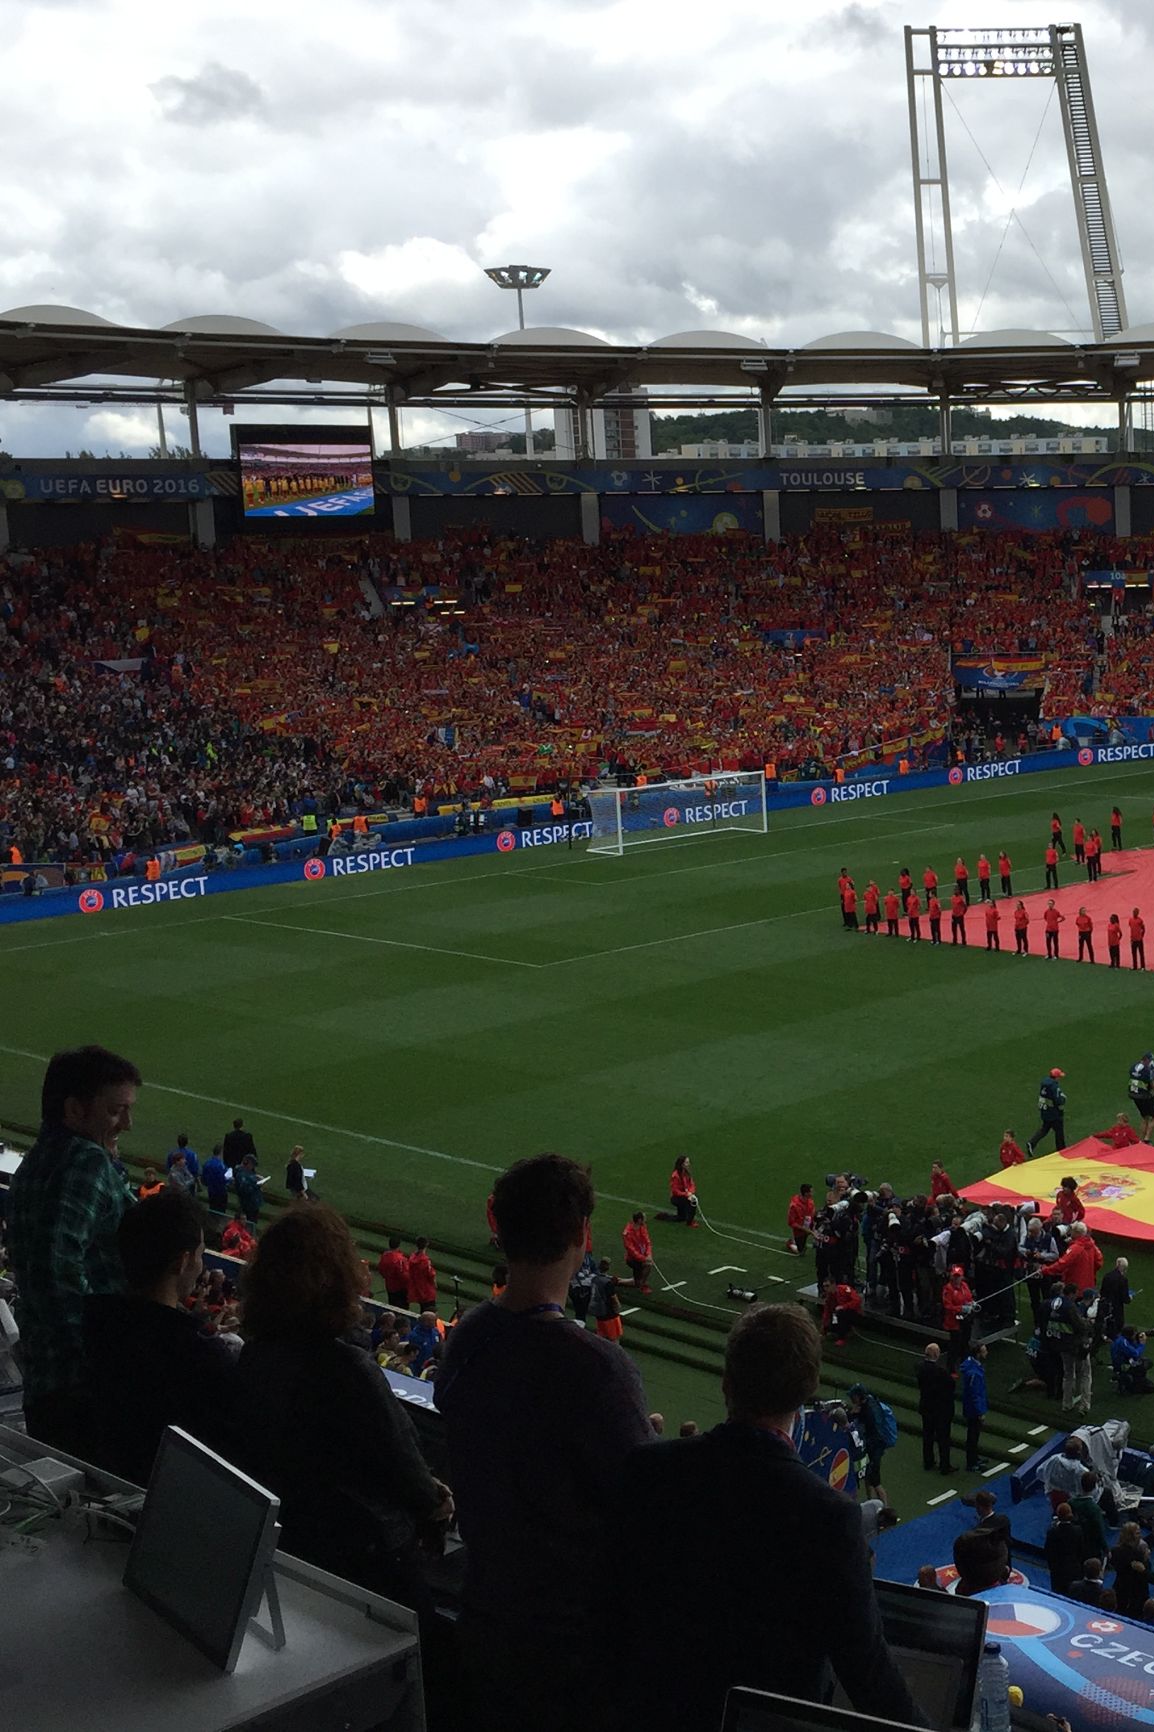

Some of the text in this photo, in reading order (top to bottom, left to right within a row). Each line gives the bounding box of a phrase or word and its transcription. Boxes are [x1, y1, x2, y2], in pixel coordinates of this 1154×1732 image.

[40, 479, 200, 494] UEFA EURO 2016
[779, 472, 865, 486] TOULOUSE
[967, 759, 1022, 782] RESPECT
[831, 780, 890, 803] RESPECT
[685, 800, 748, 824] RESPECT
[521, 821, 592, 848] RESPECT
[332, 848, 415, 877] RESPECT
[112, 876, 208, 908] RESPECT
